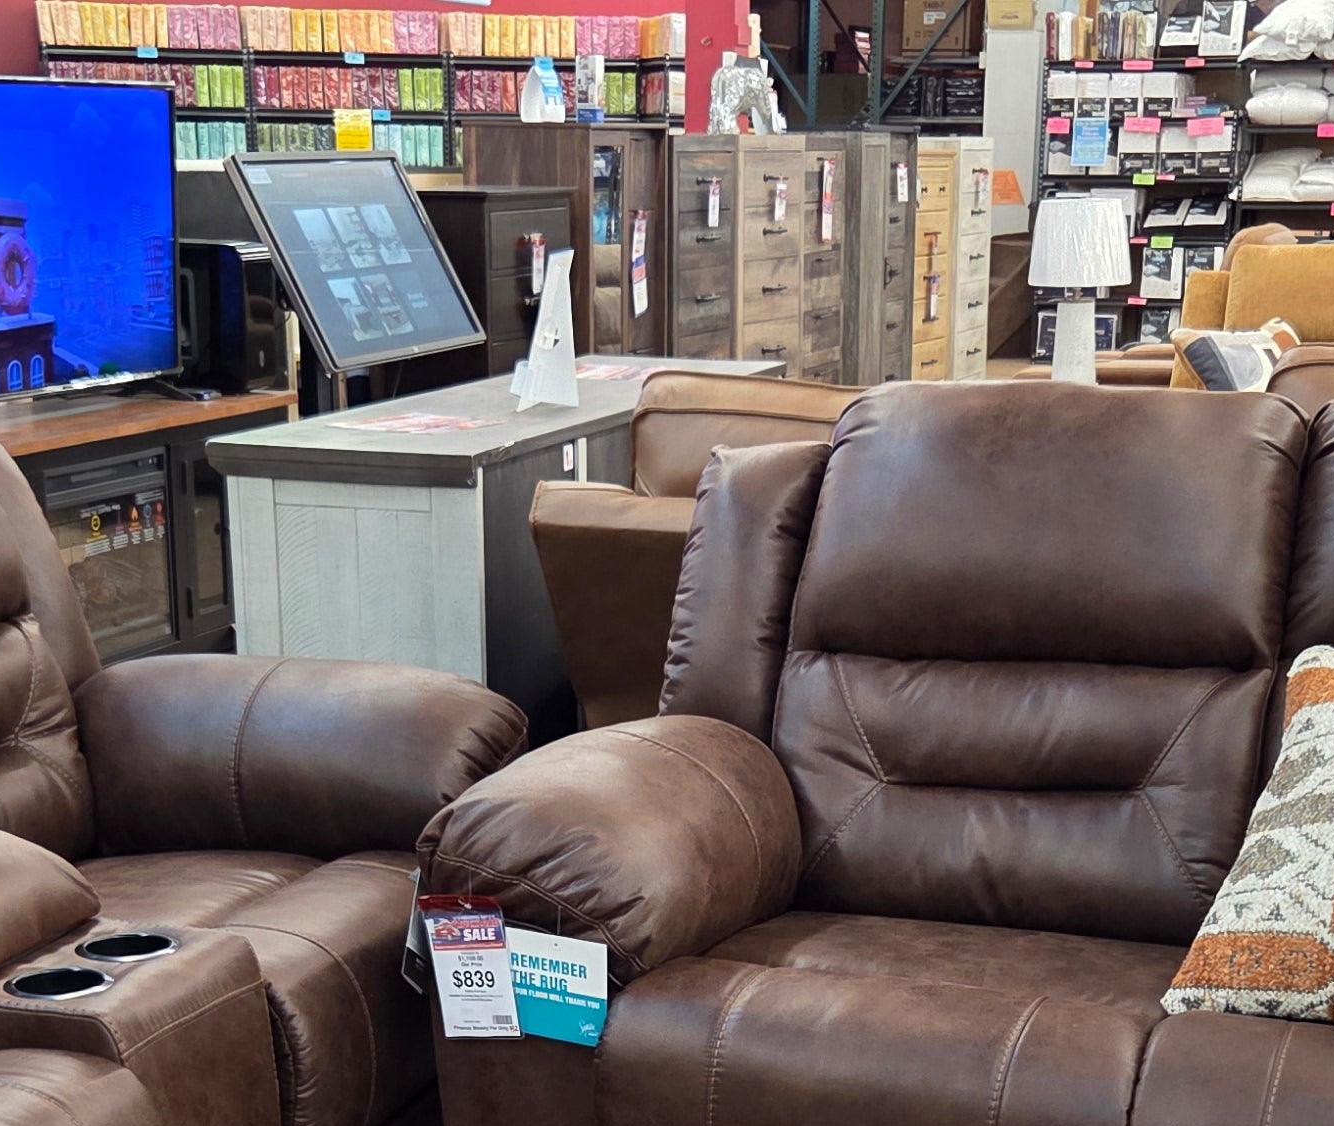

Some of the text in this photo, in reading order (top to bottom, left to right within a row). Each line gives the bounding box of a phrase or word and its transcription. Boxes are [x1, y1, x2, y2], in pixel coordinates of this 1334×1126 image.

[463, 928, 496, 941] SALE
[510, 952, 587, 979] REMEMBER
[452, 969, 495, 989] $839
[510, 969, 568, 991] THE RUG
[528, 989, 548, 999] FLOOR
[548, 993, 564, 1003] WILL
[565, 996, 587, 1007] THANK
[587, 1000, 600, 1010] YOU
